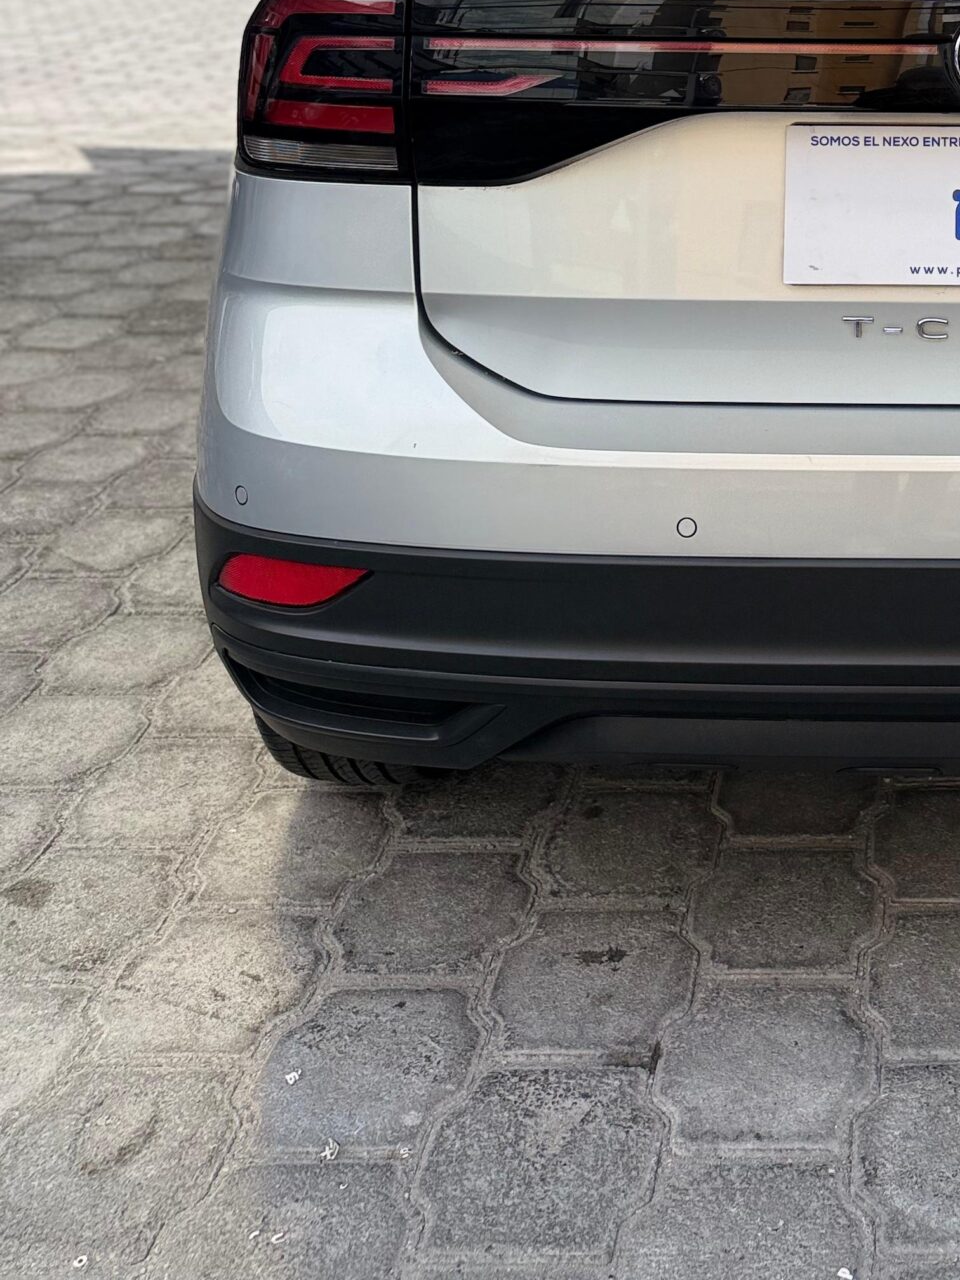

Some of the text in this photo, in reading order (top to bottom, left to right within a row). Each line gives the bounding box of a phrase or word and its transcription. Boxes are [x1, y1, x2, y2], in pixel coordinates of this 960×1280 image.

[810, 135, 860, 147] SOMOS
[863, 136, 880, 147] EL
[882, 136, 920, 147] NEXO
